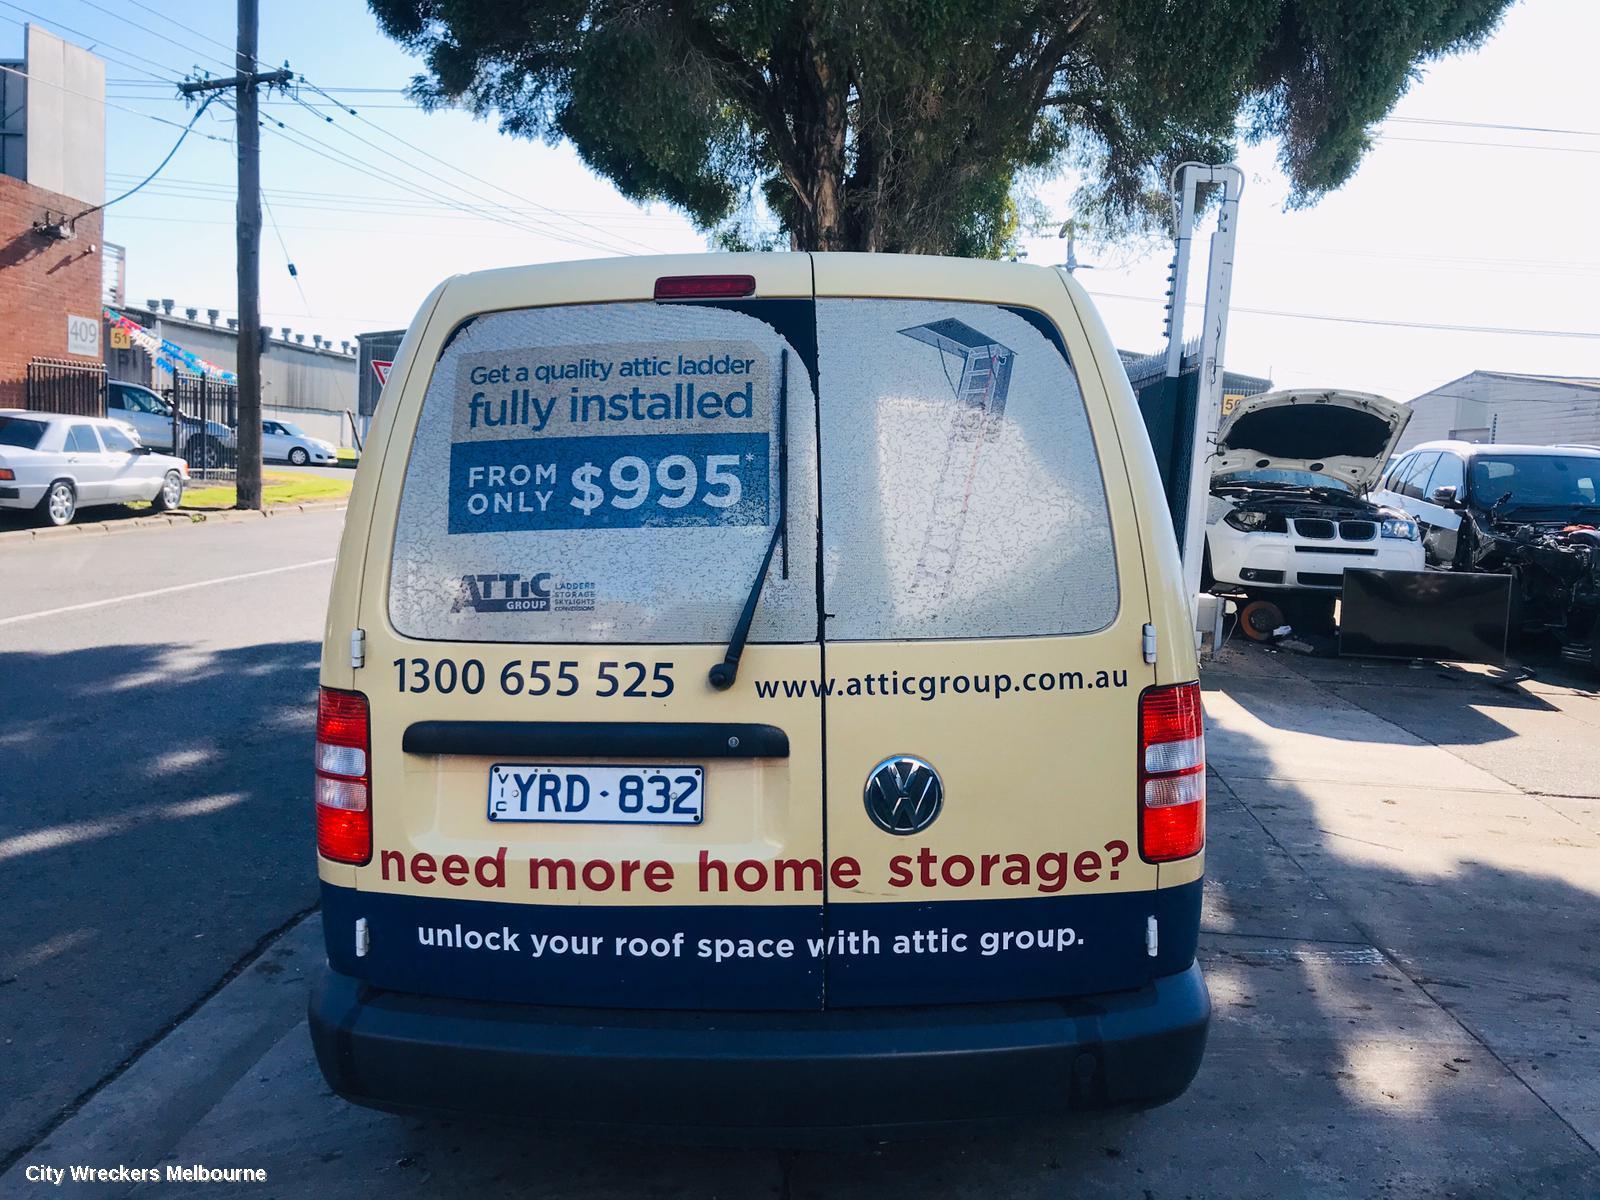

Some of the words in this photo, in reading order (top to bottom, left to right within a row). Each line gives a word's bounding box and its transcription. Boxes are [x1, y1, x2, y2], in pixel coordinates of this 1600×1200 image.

[70, 320, 97, 343] 409
[114, 332, 127, 344] 51
[470, 366, 510, 386] Get
[516, 367, 529, 382] a
[534, 357, 614, 384] quality
[619, 356, 672, 378] attic
[677, 354, 755, 376] ladder
[468, 389, 556, 432] fully
[570, 382, 753, 423] installed
[468, 463, 557, 488] FROM
[467, 490, 554, 516] ONLY
[555, 582, 595, 590] LADDERS
[506, 601, 547, 611] GROUP
[393, 658, 486, 695] 1300
[500, 659, 580, 697] 655
[595, 661, 675, 698] 525
[755, 669, 1128, 701] www.atticgroup.com.au
[380, 847, 508, 889] need
[529, 857, 675, 892] more
[698, 850, 861, 893] home
[887, 839, 1130, 893] storage?
[418, 924, 520, 952] unlock
[530, 932, 603, 957] your
[615, 932, 684, 957] roof
[697, 936, 794, 963] space
[807, 929, 880, 957] with
[892, 928, 968, 954] attic
[980, 926, 1085, 956] group.
